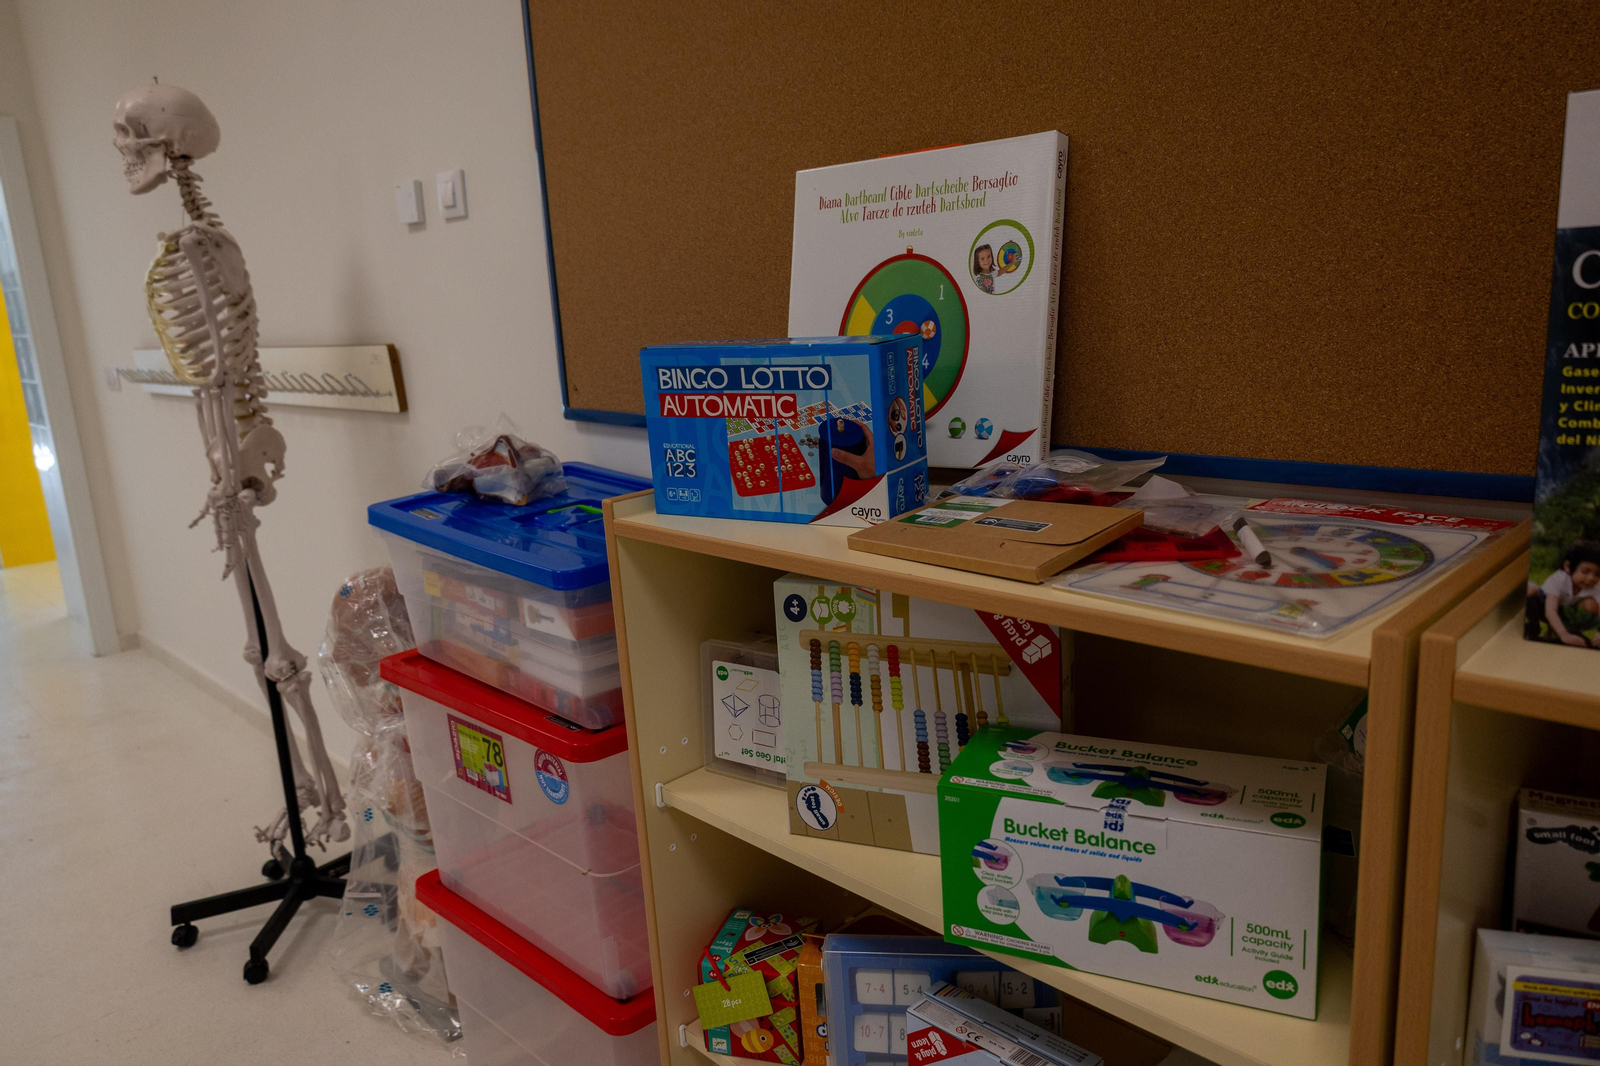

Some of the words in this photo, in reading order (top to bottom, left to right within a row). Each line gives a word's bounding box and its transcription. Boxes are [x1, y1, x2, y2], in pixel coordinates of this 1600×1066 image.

[819, 195, 842, 210] Diana
[845, 187, 887, 207] Dartboard
[890, 185, 912, 201] Cible
[915, 176, 968, 199] Dartscheibe
[972, 171, 1019, 193] Bersaglio
[840, 209, 859, 224] Alvo
[862, 206, 890, 222] Tarcze
[892, 202, 904, 218] do
[940, 191, 987, 212] Dartsbord
[939, 284, 944, 301] 1
[885, 308, 894, 325] 3
[1563, 342, 1600, 359] AP
[922, 353, 930, 370] 4
[658, 367, 728, 390] BINGO
[740, 366, 831, 390] LOTTO
[907, 349, 917, 431] AUTOMATIC
[662, 394, 796, 418] AUTOMATIC
[1559, 402, 1569, 414] y
[915, 397, 923, 449] LOTTO
[1556, 433, 1581, 446] del
[666, 449, 696, 463] ABC
[1006, 454, 1031, 464] cayro
[666, 462, 696, 478] 123
[851, 506, 882, 520] cayro
[1392, 511, 1464, 524] FACE
[789, 599, 800, 616] 4+
[1001, 618, 1028, 647] play
[482, 738, 504, 768] 78
[741, 748, 754, 757] Set
[756, 751, 771, 761] Geo
[1054, 741, 1118, 756] Bucket
[1121, 750, 1198, 767] Balance
[825, 784, 843, 807] DESIGN
[1252, 793, 1303, 804] capacity
[1257, 788, 1300, 799] 500mL
[1200, 812, 1225, 820] edx
[1273, 817, 1302, 826] edx
[1004, 818, 1068, 842] Bucket
[1074, 829, 1156, 855] Balance
[1533, 830, 1567, 839] small
[1570, 832, 1596, 846] foot
[1004, 836, 1029, 846] Measure
[1030, 840, 1050, 849] volume
[1064, 846, 1080, 854] mass
[1089, 849, 1107, 858] solids
[1108, 852, 1120, 860] and
[1121, 854, 1143, 863] liquids
[1246, 923, 1291, 940] 500mL
[1030, 942, 1051, 951] HAZARD
[1242, 935, 1294, 952] capacity
[1241, 946, 1269, 957] Activity
[1270, 951, 1294, 961] Guide
[1195, 975, 1219, 986] edx
[1265, 979, 1296, 992] edx
[865, 983, 871, 993] 7
[879, 984, 885, 994] 4
[903, 984, 909, 995] 5
[917, 985, 923, 995] 4
[983, 984, 989, 996] 4
[1002, 982, 1013, 995] 15
[1021, 981, 1028, 995] 2
[721, 999, 731, 1008] 28
[860, 1025, 870, 1038] 10
[879, 1026, 885, 1038] 7
[900, 1028, 905, 1041] 8
[911, 1037, 931, 1049] learn
[920, 1045, 937, 1058] play
